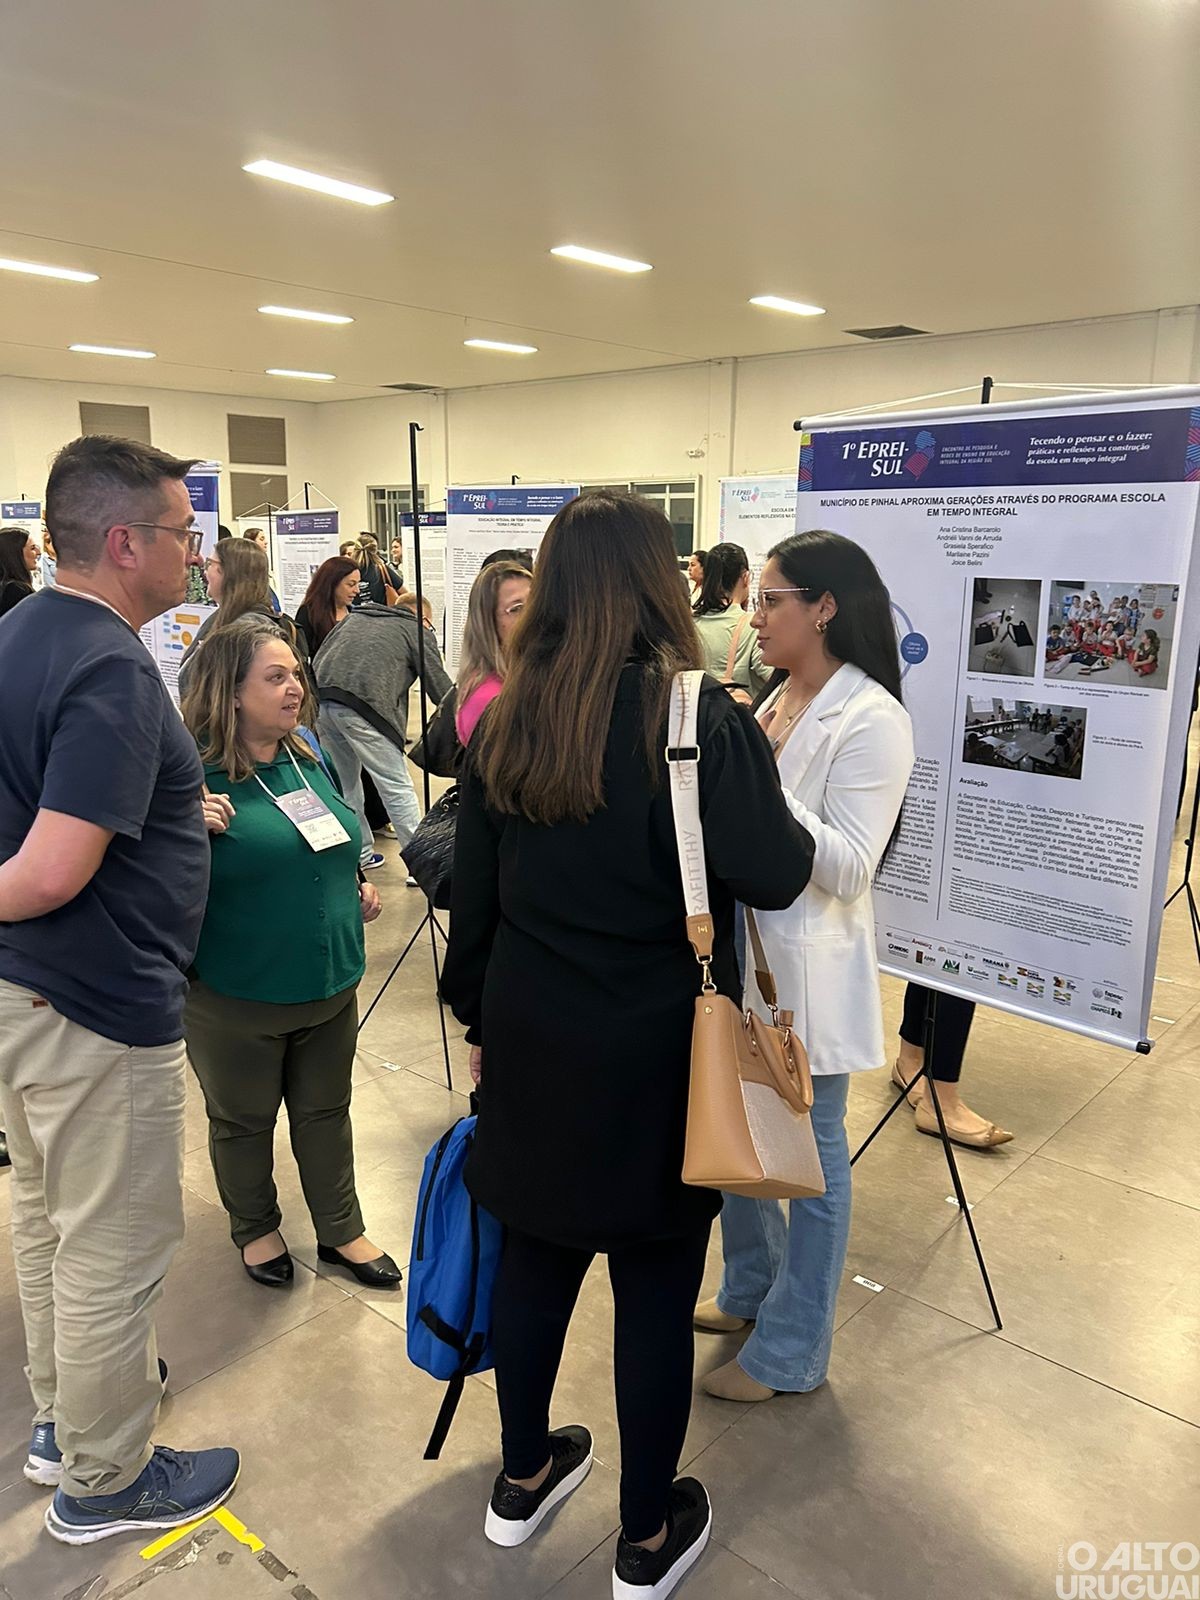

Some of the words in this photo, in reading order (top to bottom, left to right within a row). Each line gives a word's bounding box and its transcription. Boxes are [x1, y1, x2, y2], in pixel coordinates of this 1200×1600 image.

[1030, 435, 1065, 446] Tecendo
[1075, 434, 1106, 446] pensar
[1126, 431, 1153, 441] fazer:
[842, 442, 856, 459] 1º
[858, 441, 909, 459] EPREI-
[1028, 448, 1055, 457] práticas
[1063, 446, 1095, 454] reflexões
[1108, 442, 1150, 452] construção
[1072, 456, 1096, 465] tempo
[1098, 454, 1127, 464] integral
[870, 459, 903, 477] SUL
[820, 497, 857, 506] MUNICÍPIO
[871, 498, 899, 506] PINHAL
[900, 496, 944, 505] APROXIMA
[947, 494, 994, 506] GERAÇÕES
[996, 494, 1039, 504] ATRAVÉS
[1041, 495, 1056, 503] DO
[1058, 494, 1118, 503] PROGRAMA
[1120, 493, 1166, 502] ESCOLA
[927, 508, 940, 516] EM
[942, 508, 971, 516] TEMPO
[973, 508, 1018, 516] INTEGRAL
[916, 757, 940, 765] Educação
[959, 778, 988, 787] Avaliação
[963, 793, 988, 802] Secretaria
[997, 799, 1024, 809] Educação,
[1026, 804, 1047, 813] Cultura,
[1049, 808, 1074, 817] Desporto
[1082, 813, 1104, 822] Turismo
[1105, 819, 1127, 827] pensou
[988, 811, 1005, 819] Tempo
[1031, 819, 1059, 829] transforma
[1100, 832, 1124, 841] crianças
